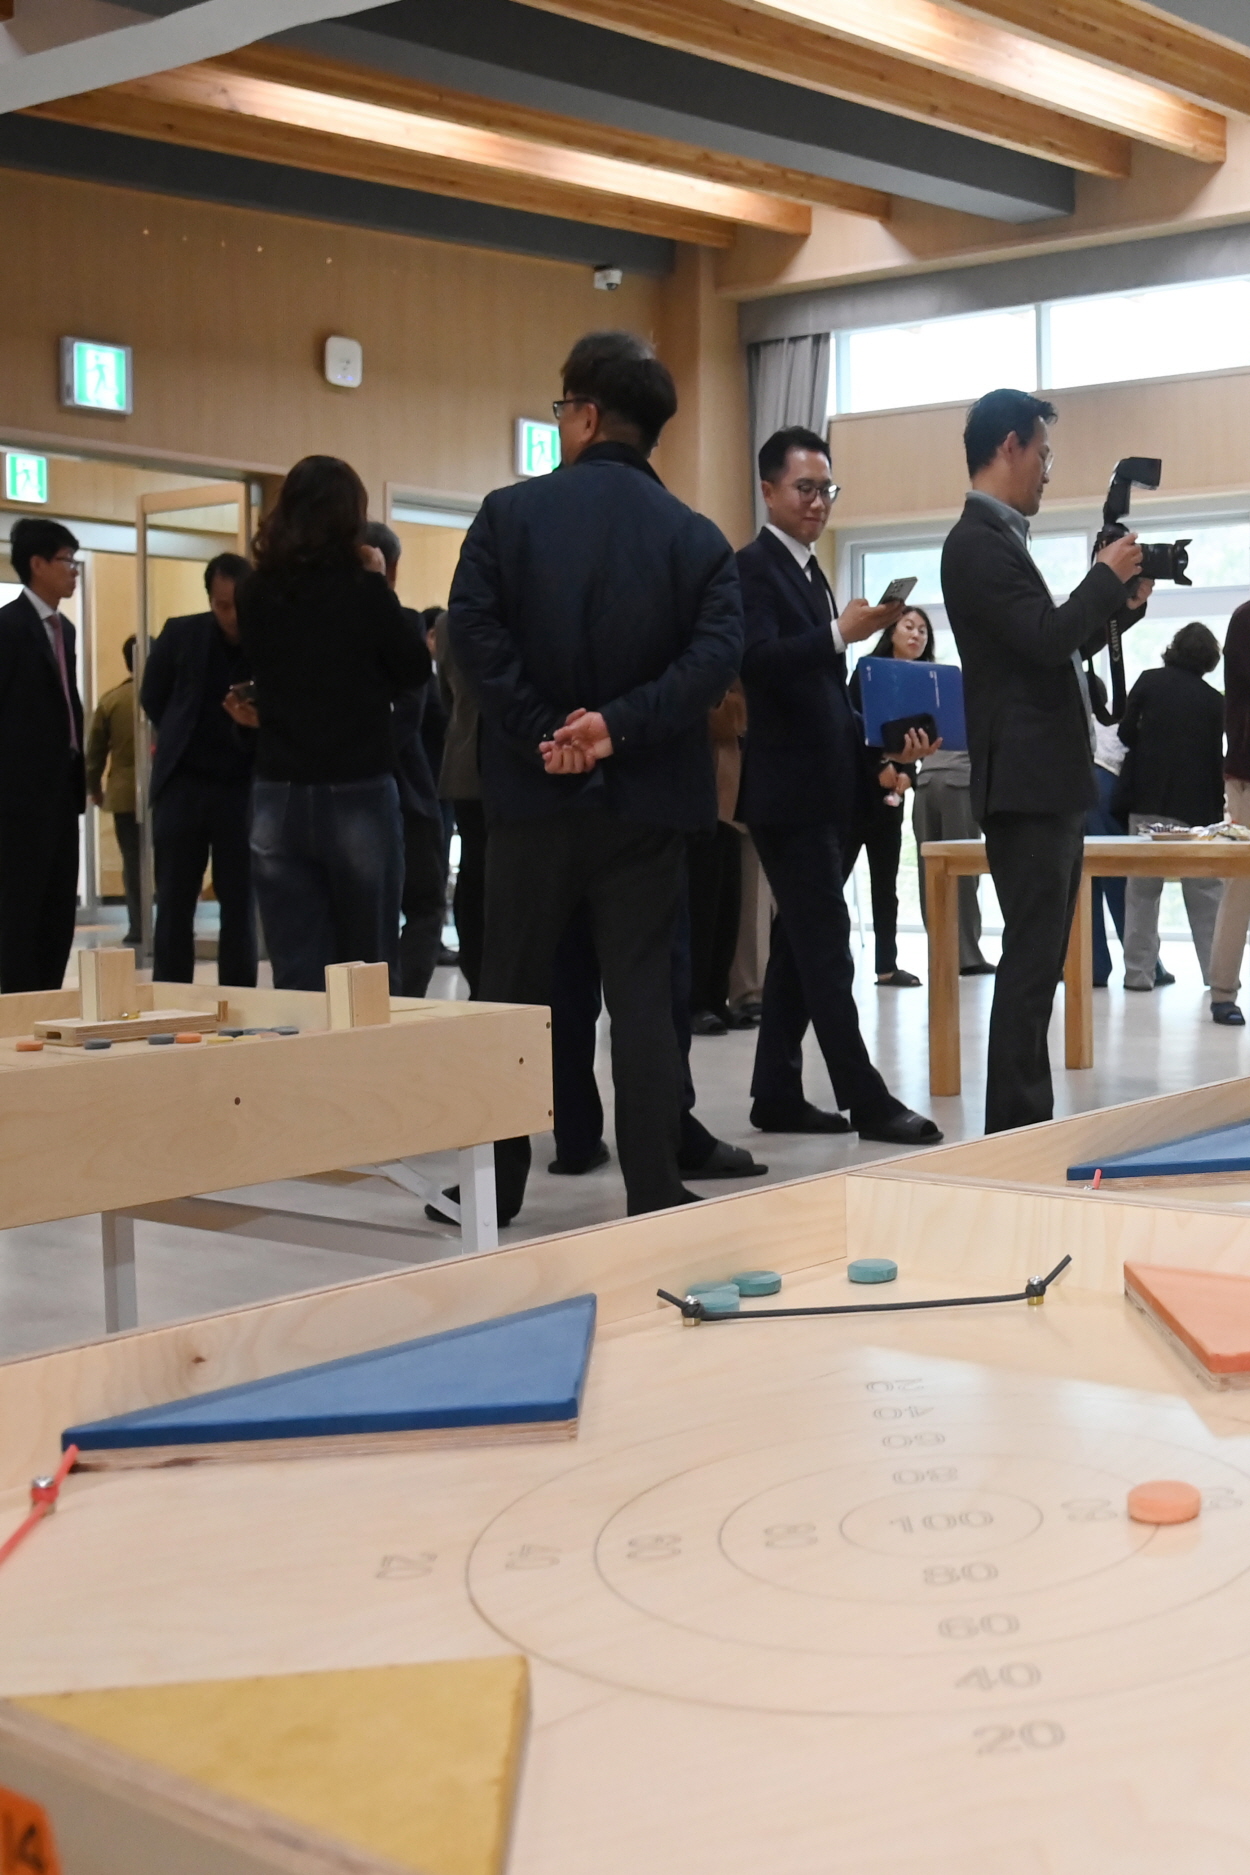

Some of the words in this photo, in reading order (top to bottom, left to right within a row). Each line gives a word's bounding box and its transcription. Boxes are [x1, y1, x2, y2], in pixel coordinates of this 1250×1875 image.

[889, 1509, 994, 1534] 100
[923, 1561, 998, 1586] 80
[938, 1612, 1020, 1640] 60
[954, 1662, 1042, 1691] 40
[972, 1718, 1066, 1756] 20
